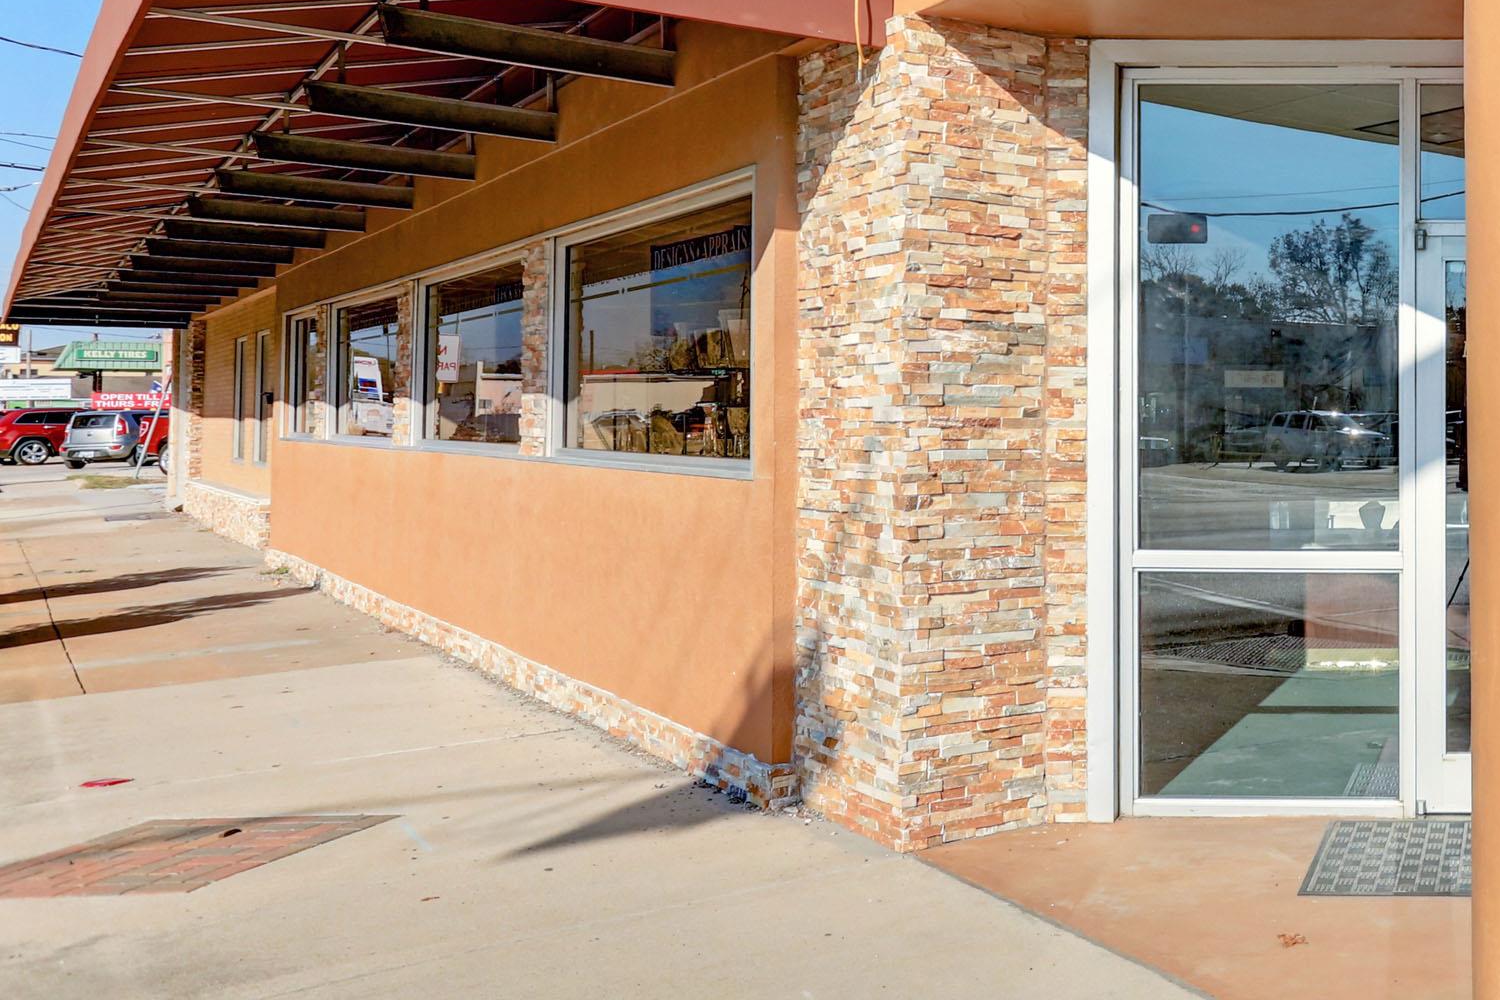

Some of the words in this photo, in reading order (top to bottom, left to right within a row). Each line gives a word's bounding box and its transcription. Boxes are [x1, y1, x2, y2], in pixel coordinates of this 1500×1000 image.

[83, 350, 116, 359] KELLY
[118, 350, 148, 359] TIRES
[100, 393, 133, 401] OPEN
[135, 393, 160, 401] TILL
[94, 400, 135, 408] THURS
[143, 400, 161, 408] FR
